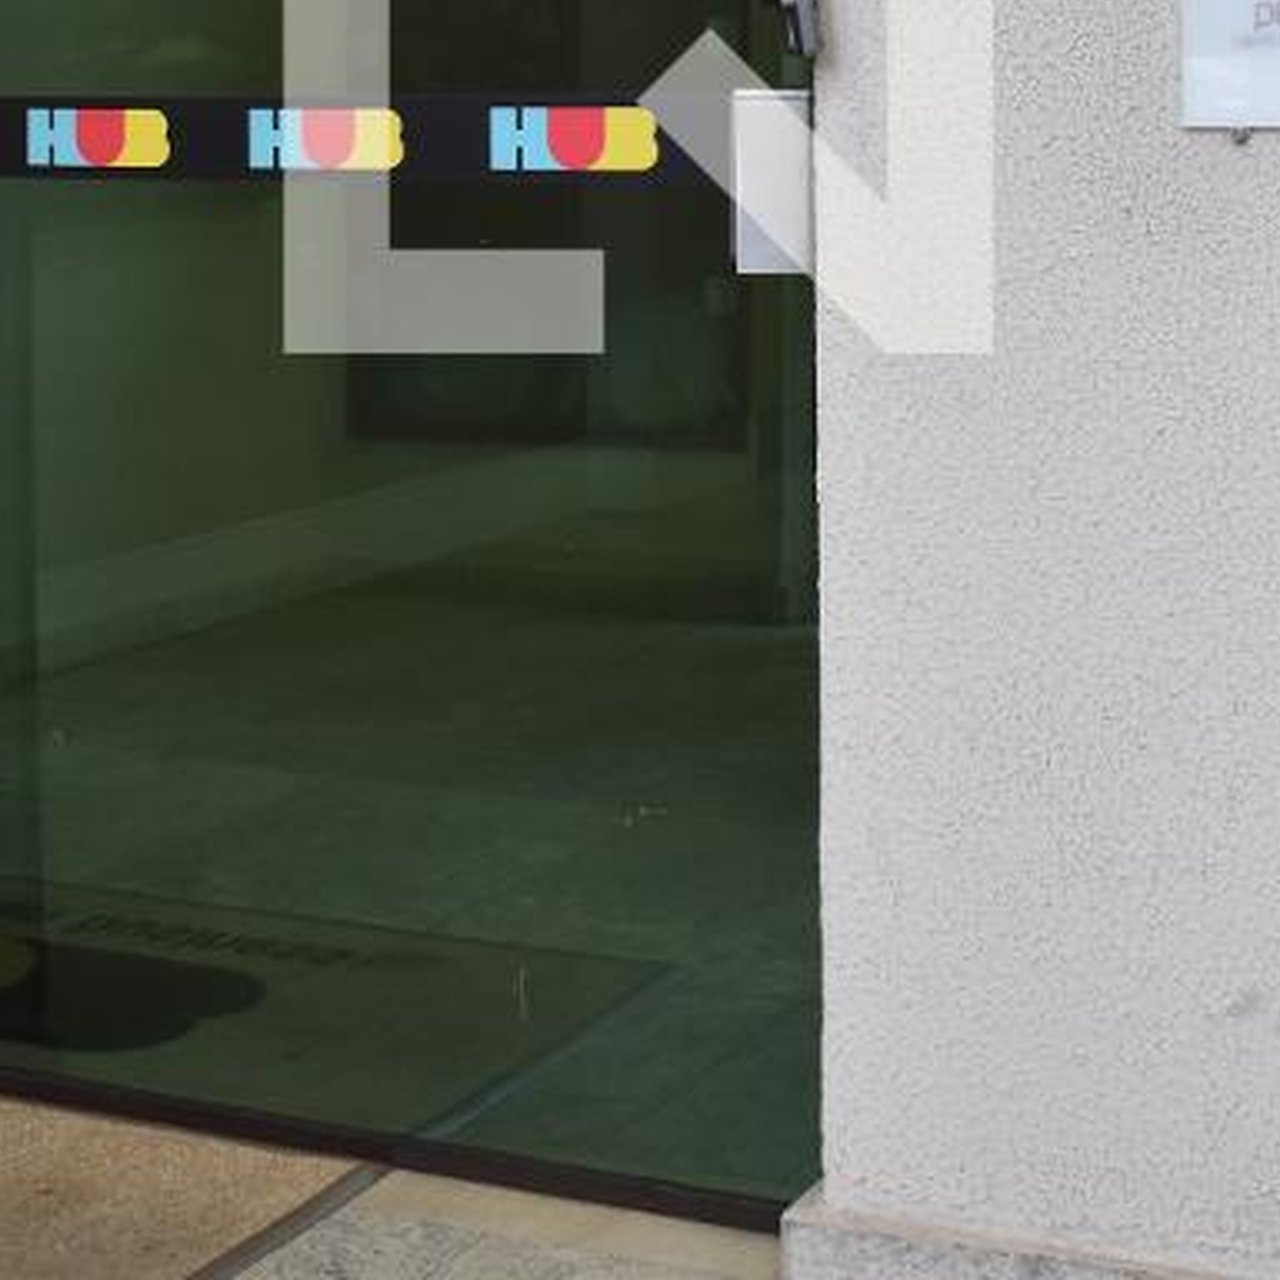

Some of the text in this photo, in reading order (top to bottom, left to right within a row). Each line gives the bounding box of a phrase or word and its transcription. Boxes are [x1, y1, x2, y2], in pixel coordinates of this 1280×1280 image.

[26, 107, 169, 168] HUB
[248, 108, 403, 171] HUB
[489, 106, 658, 171] HUB
